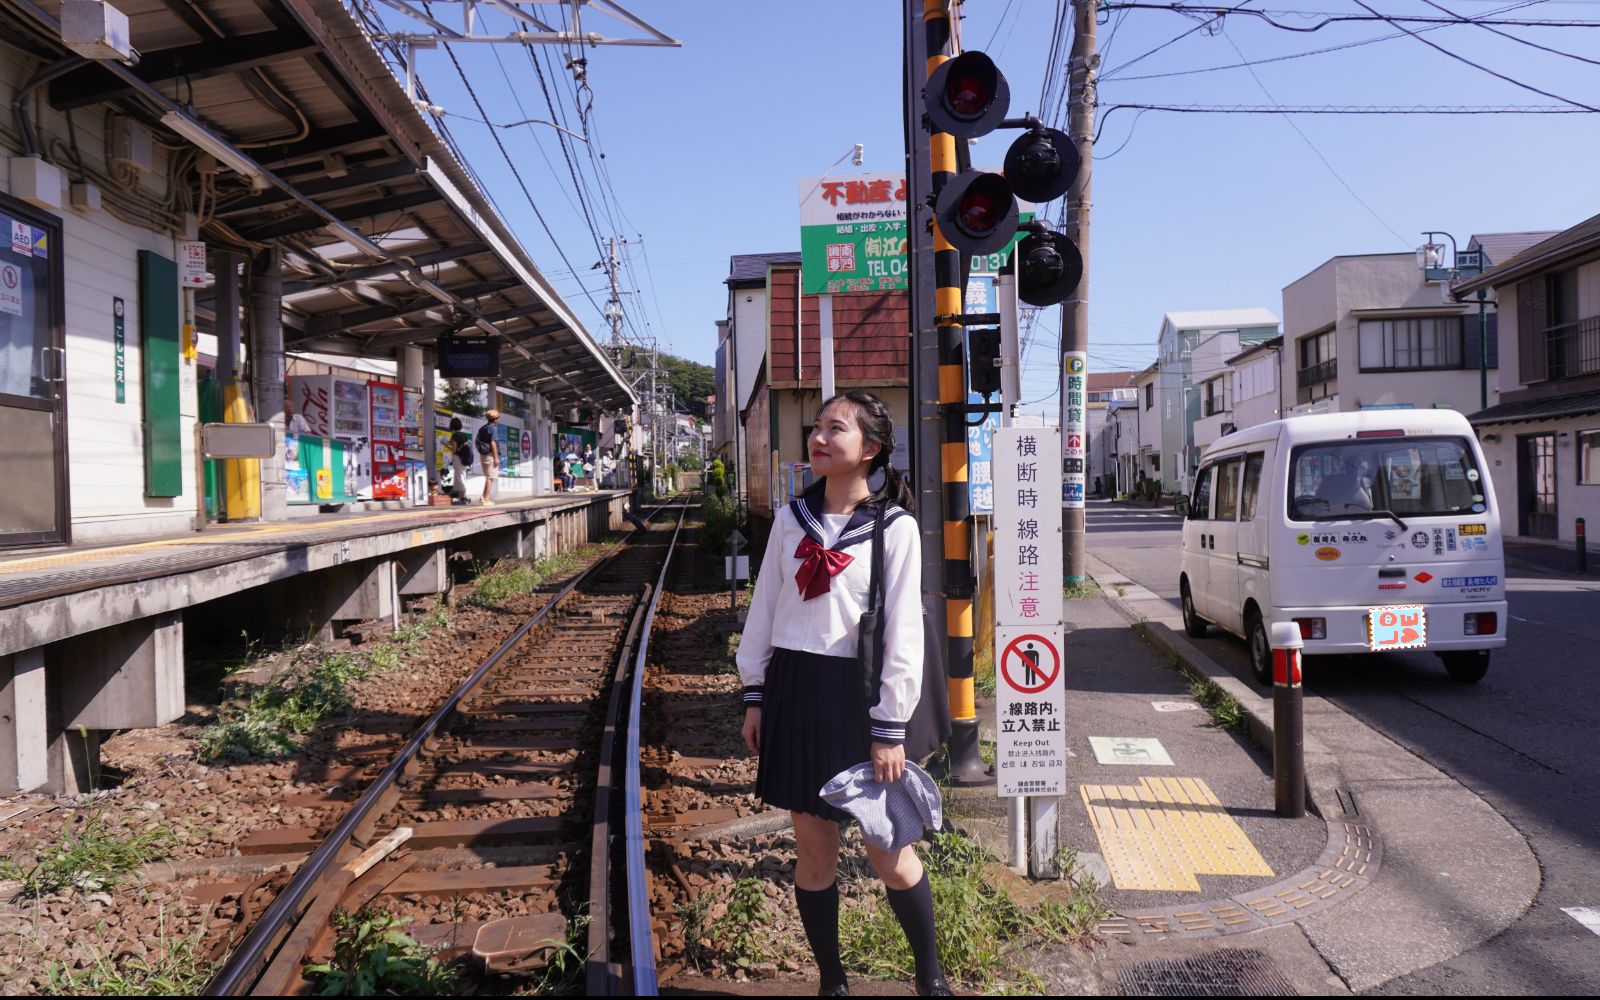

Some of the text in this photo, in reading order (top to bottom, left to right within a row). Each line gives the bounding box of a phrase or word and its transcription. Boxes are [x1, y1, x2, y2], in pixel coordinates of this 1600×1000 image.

[13, 232, 30, 245] AED
[867, 260, 888, 276] TEL
[115, 325, 124, 383] こしごえ
[1073, 360, 1082, 371] P
[1067, 376, 1082, 423] 時間貸
[972, 461, 993, 510] 腰越
[1009, 701, 1053, 716] 線路内
[1001, 718, 1061, 733] 立入禁止
[1013, 739, 1050, 748] Keep Out
[1001, 759, 1063, 769] 선로 내 진입 금지
